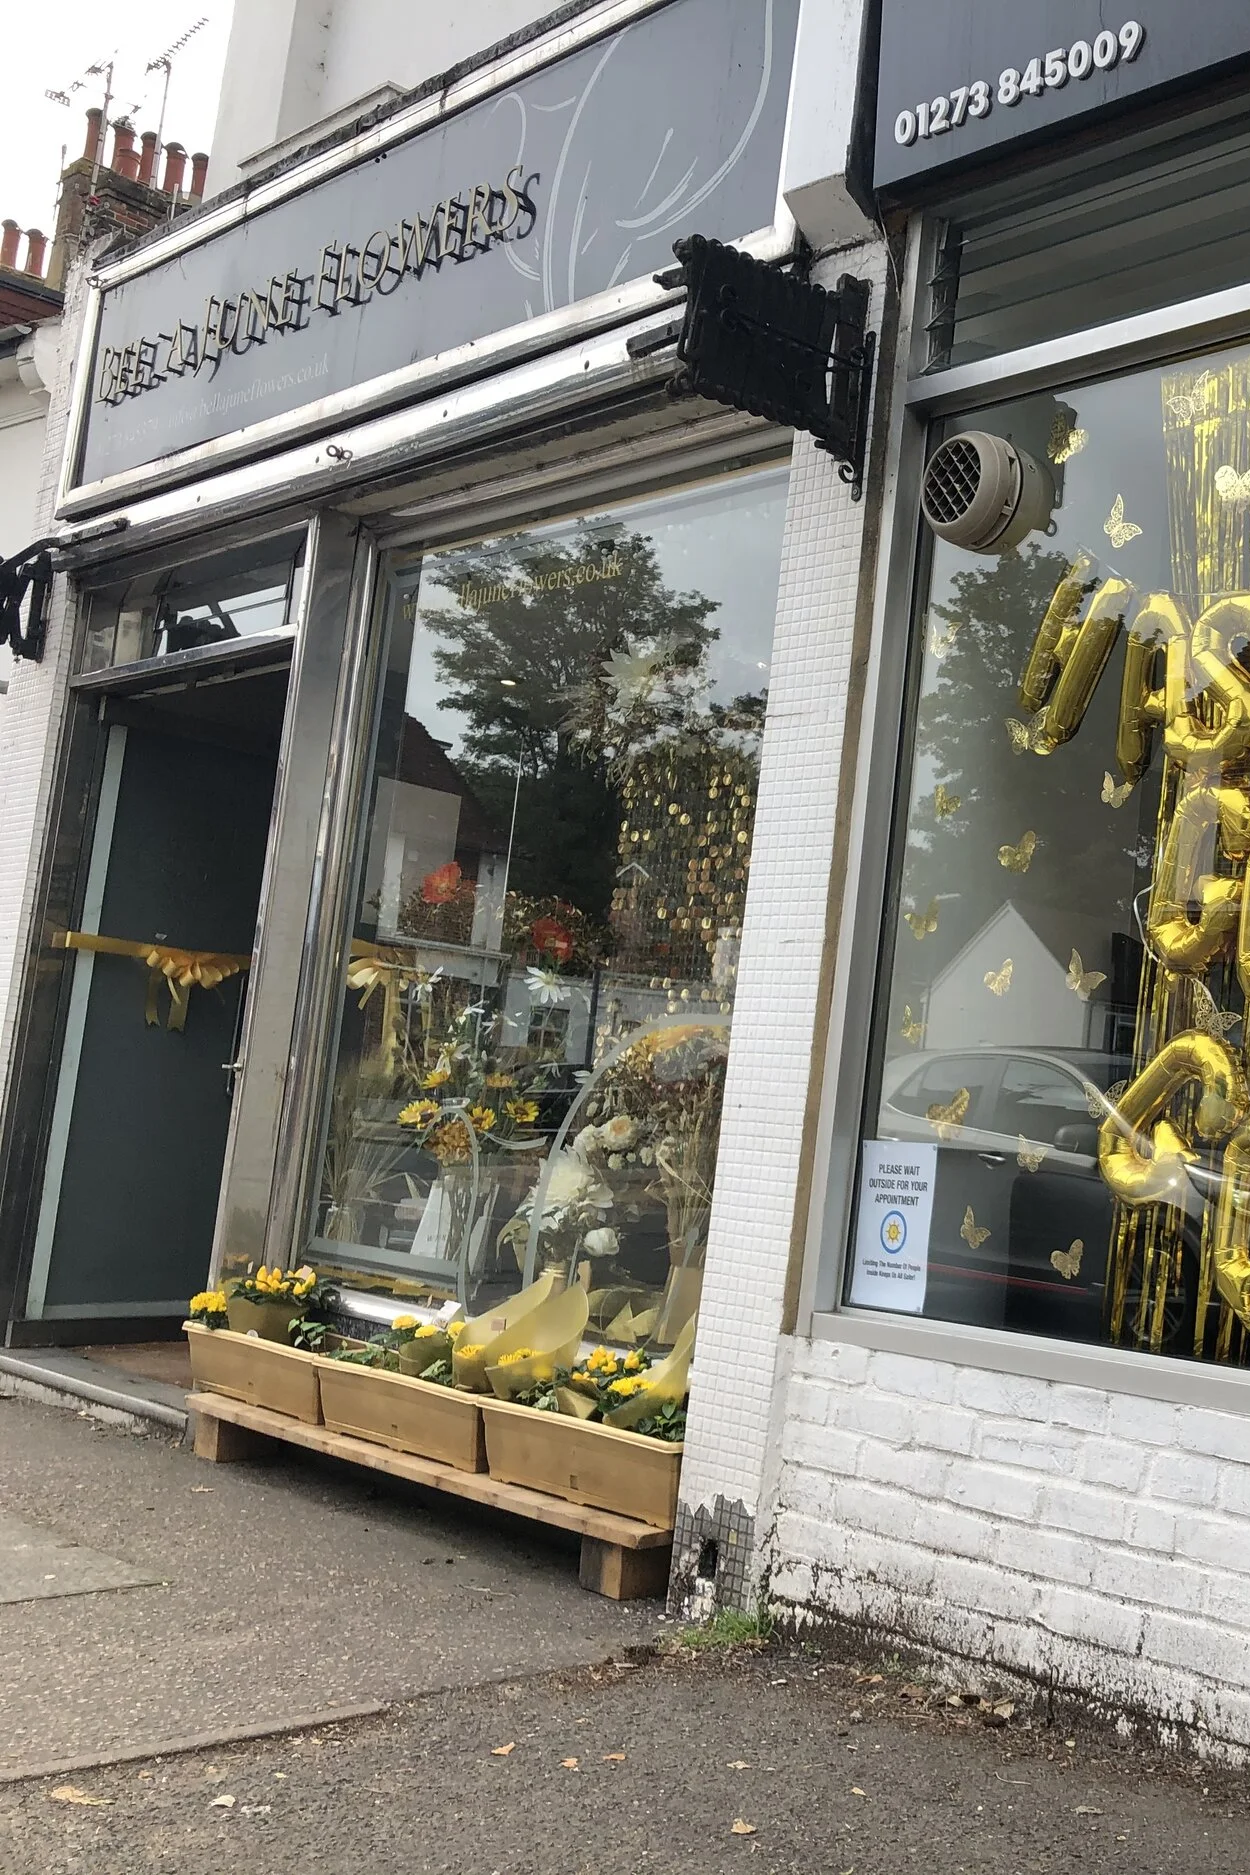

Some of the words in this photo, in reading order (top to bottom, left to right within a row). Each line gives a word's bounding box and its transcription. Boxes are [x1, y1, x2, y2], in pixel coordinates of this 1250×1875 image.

[894, 81, 990, 145] 01273
[998, 20, 1144, 106] 845009
[95, 318, 191, 404] BELA
[194, 268, 303, 378] JUNE
[312, 165, 528, 312] FLOWERS
[878, 1164, 903, 1175] PLEASE
[904, 1165, 920, 1176] WAIT
[869, 1178, 895, 1189] OUTSIDE
[896, 1180, 909, 1191] FOR
[911, 1180, 928, 1192] YOUR
[875, 1193, 919, 1206] APPOINTMENT
